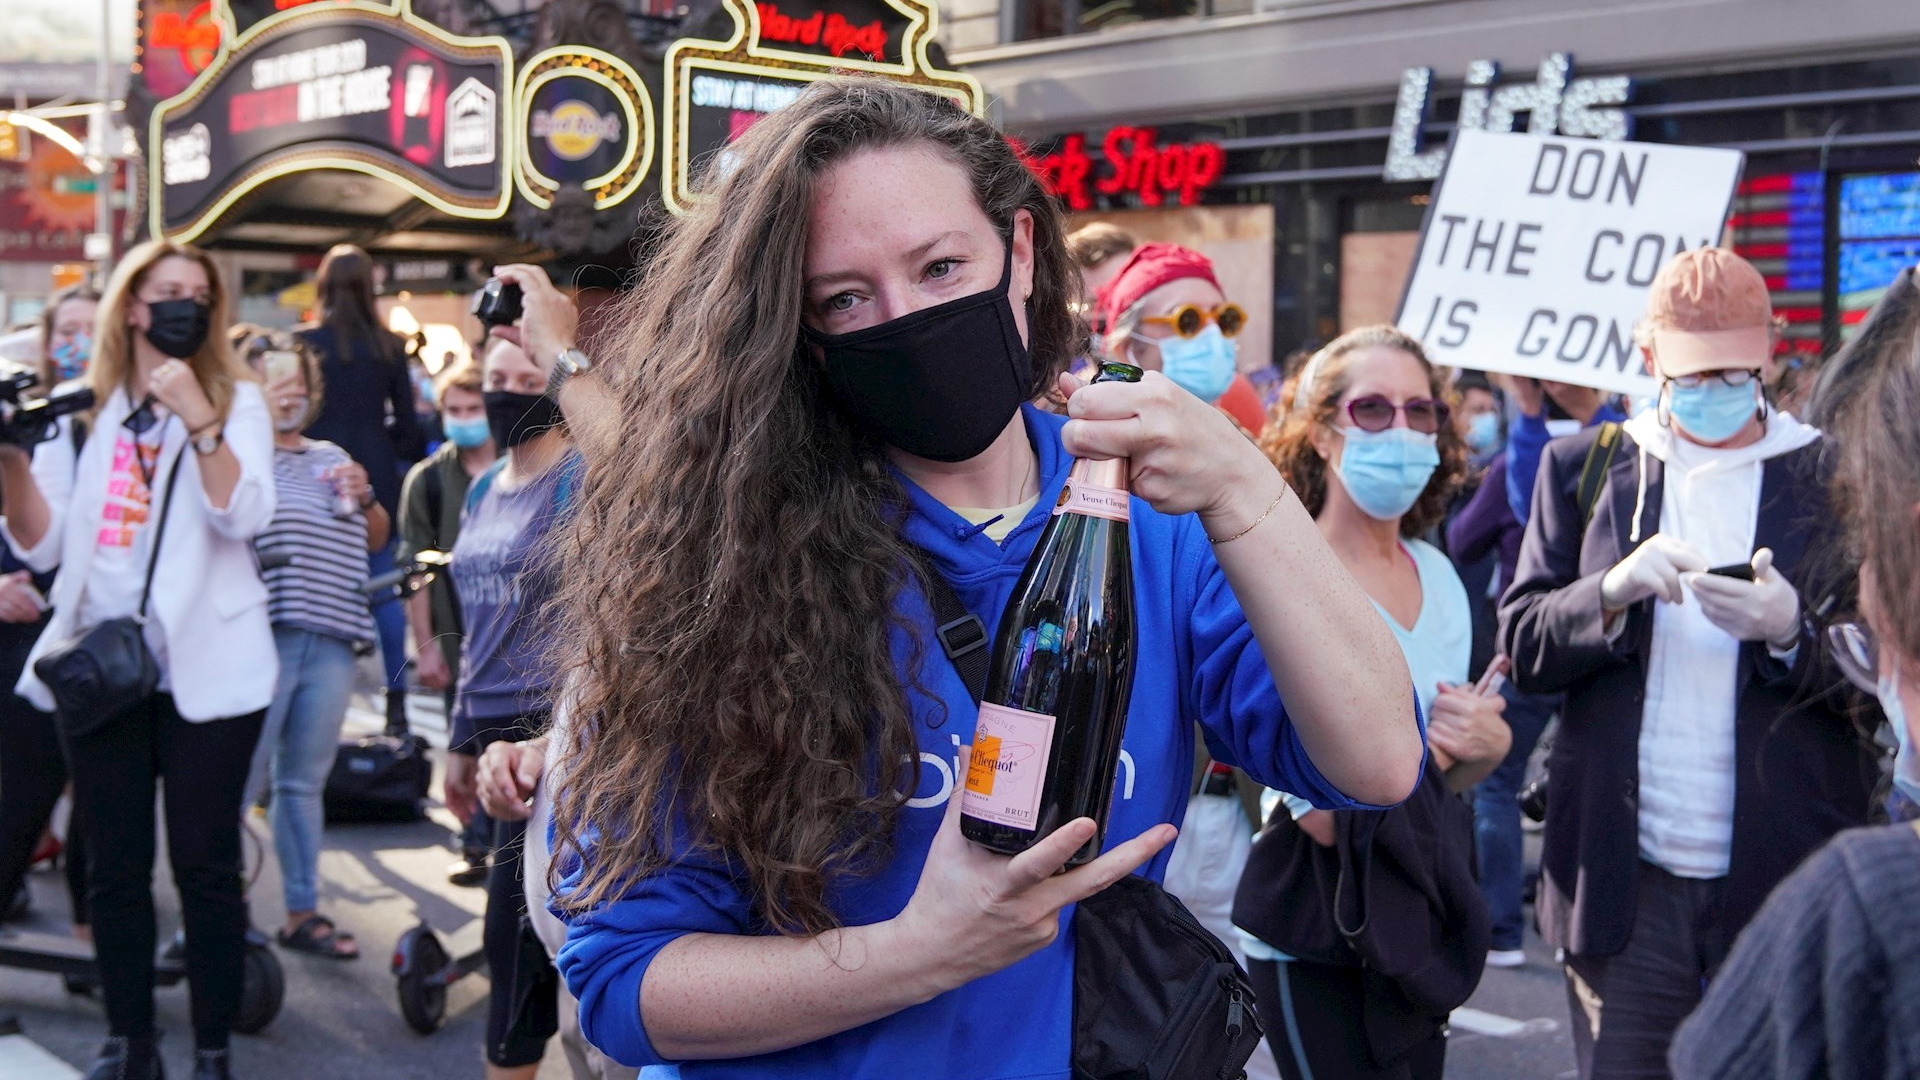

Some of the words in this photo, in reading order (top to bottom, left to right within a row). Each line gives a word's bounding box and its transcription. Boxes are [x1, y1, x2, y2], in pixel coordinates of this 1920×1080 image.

[692, 75, 735, 108] STAY
[1382, 52, 1632, 183] Lids
[1097, 125, 1225, 207] Shop
[1528, 143, 1648, 206] DON
[1438, 214, 1542, 276] THE
[1421, 296, 1478, 347] IS
[1082, 493, 1104, 504] Veuve
[1005, 806, 1031, 818] BRUT
